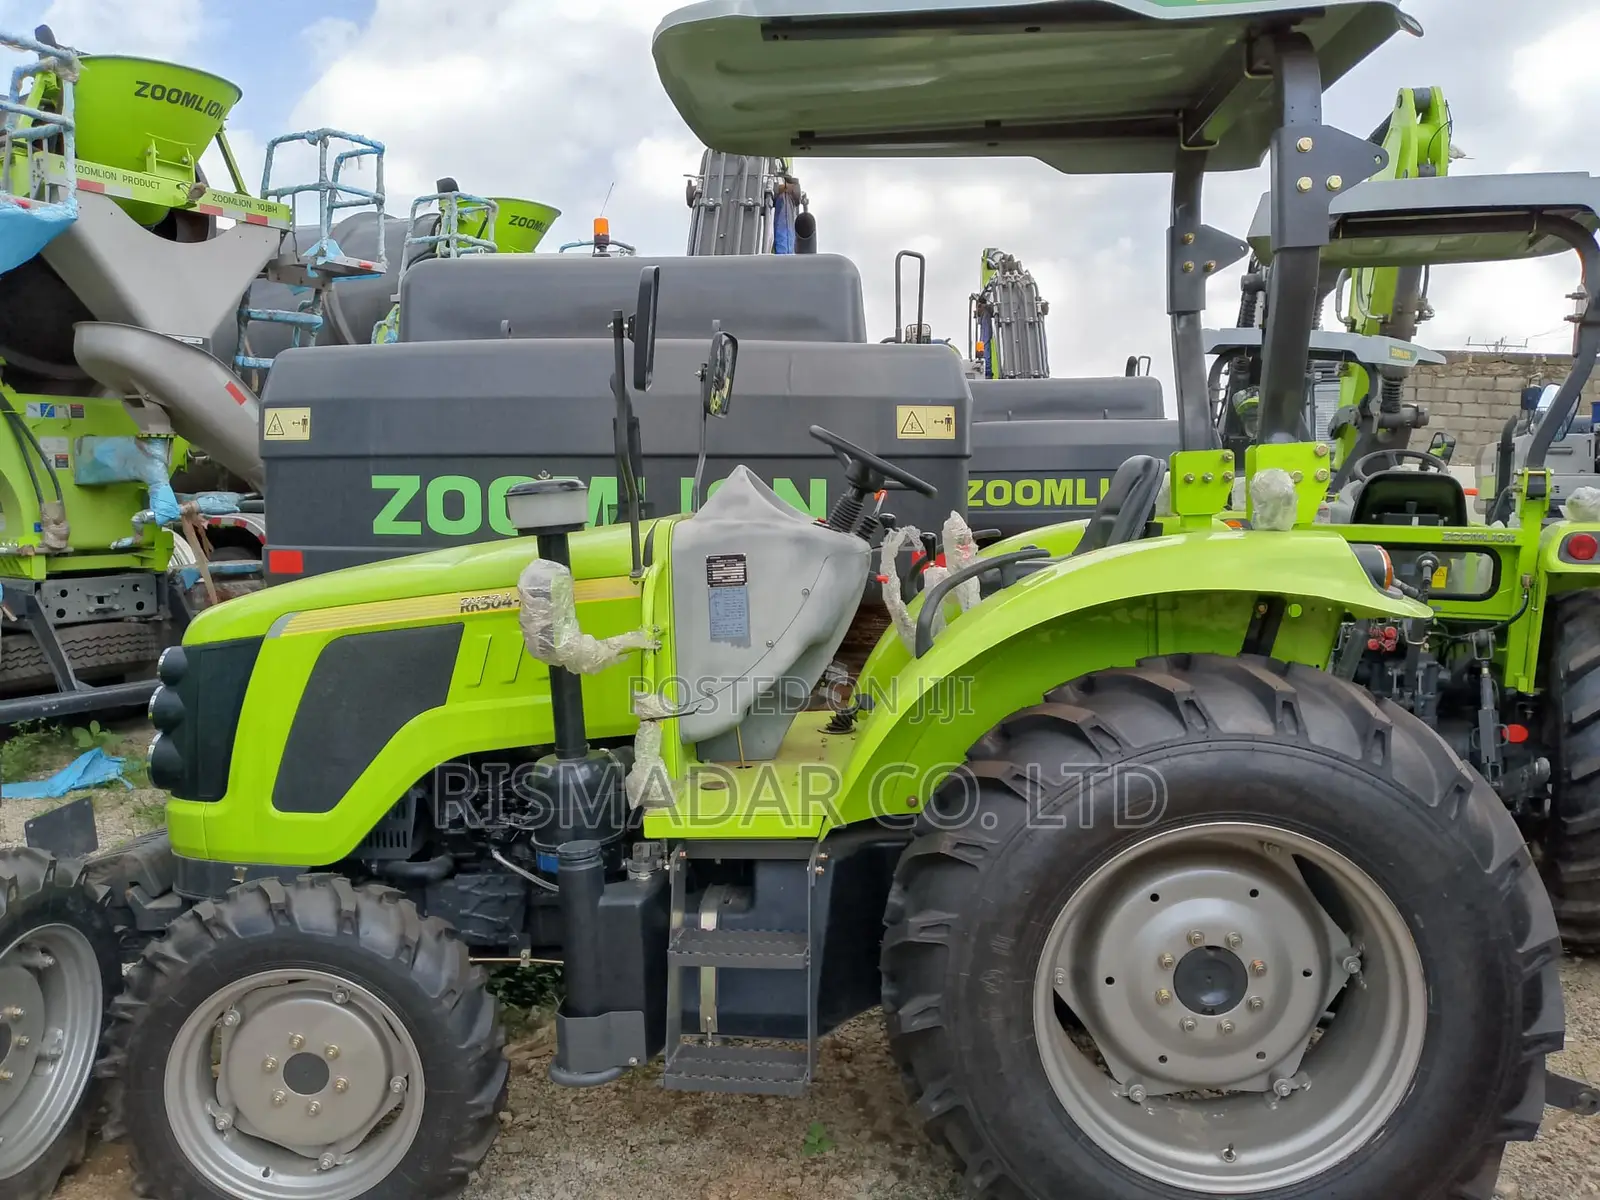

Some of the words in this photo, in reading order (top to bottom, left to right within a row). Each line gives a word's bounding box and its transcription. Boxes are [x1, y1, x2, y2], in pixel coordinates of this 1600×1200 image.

[134, 80, 226, 120] ZOOMLION
[59, 160, 66, 170] A
[122, 174, 161, 190] PRODUCT
[212, 193, 252, 209] ZOOMLION
[967, 477, 1110, 507] ZOOMLI
